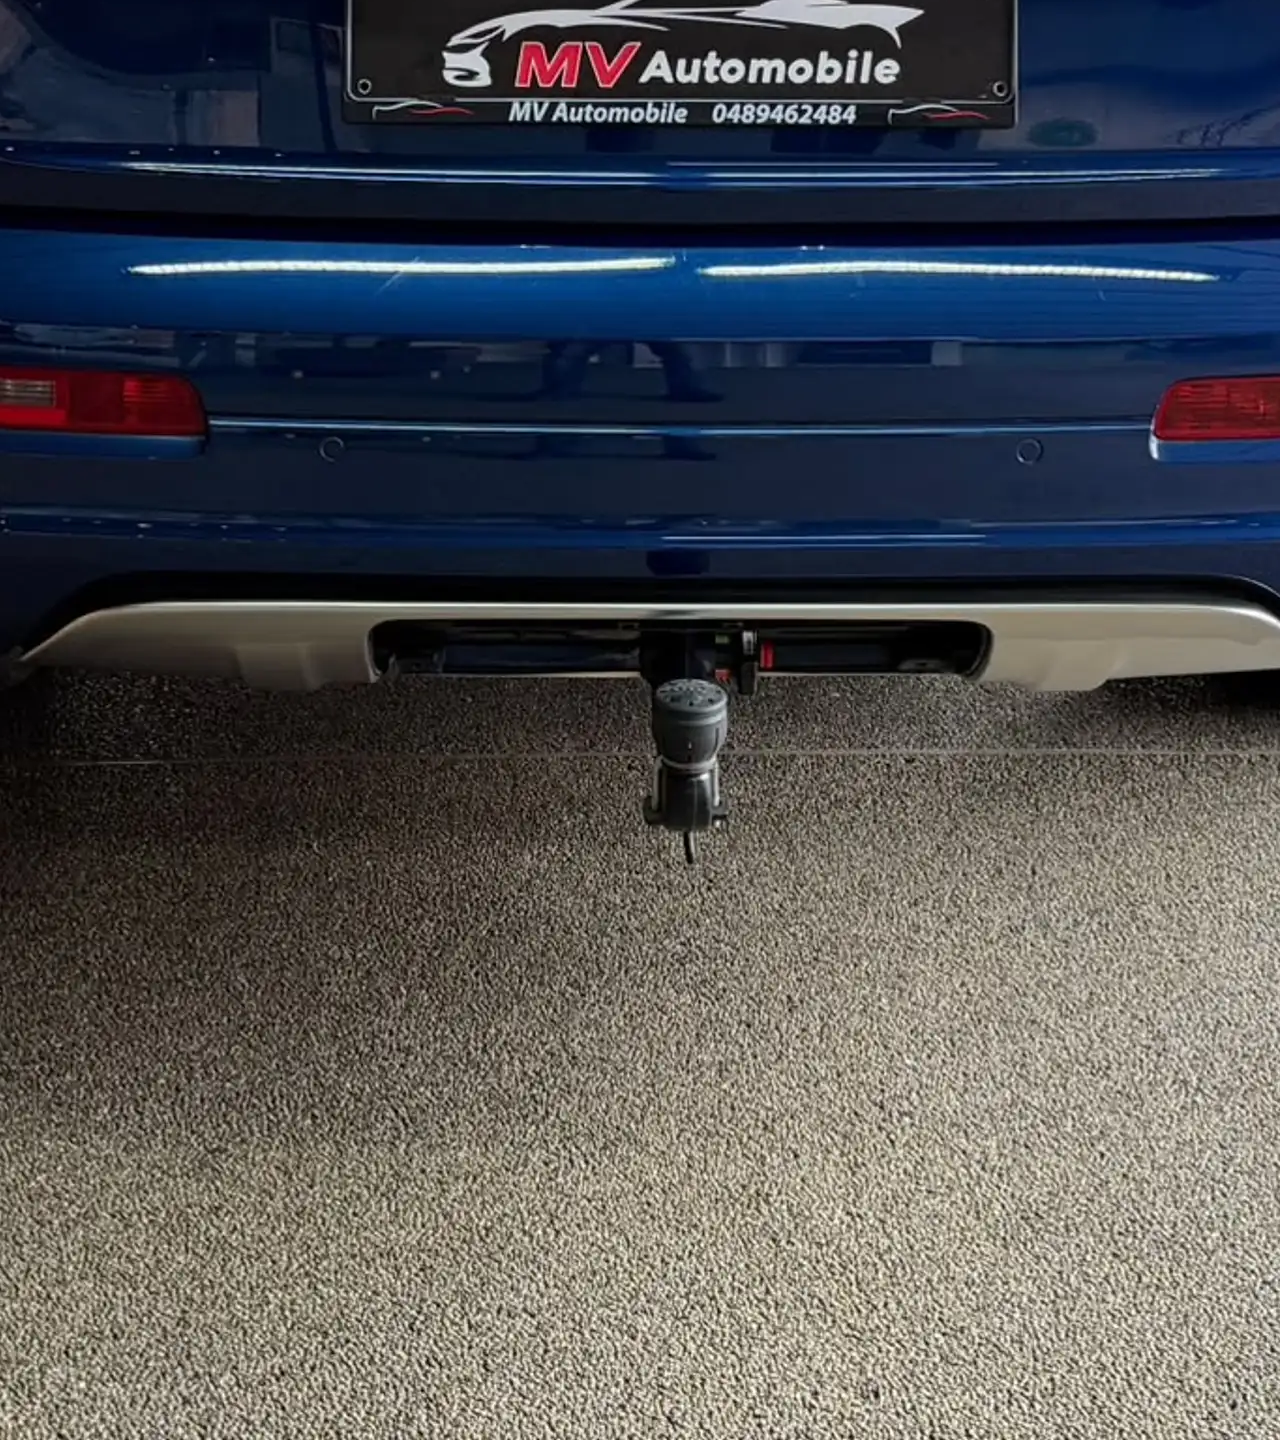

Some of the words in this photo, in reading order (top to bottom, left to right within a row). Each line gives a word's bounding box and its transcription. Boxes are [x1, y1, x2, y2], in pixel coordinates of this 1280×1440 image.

[514, 41, 642, 88] MV
[638, 49, 901, 84] Automobile
[508, 101, 550, 122] MV
[551, 101, 688, 124] Automobile
[711, 103, 857, 124] 0489462484
